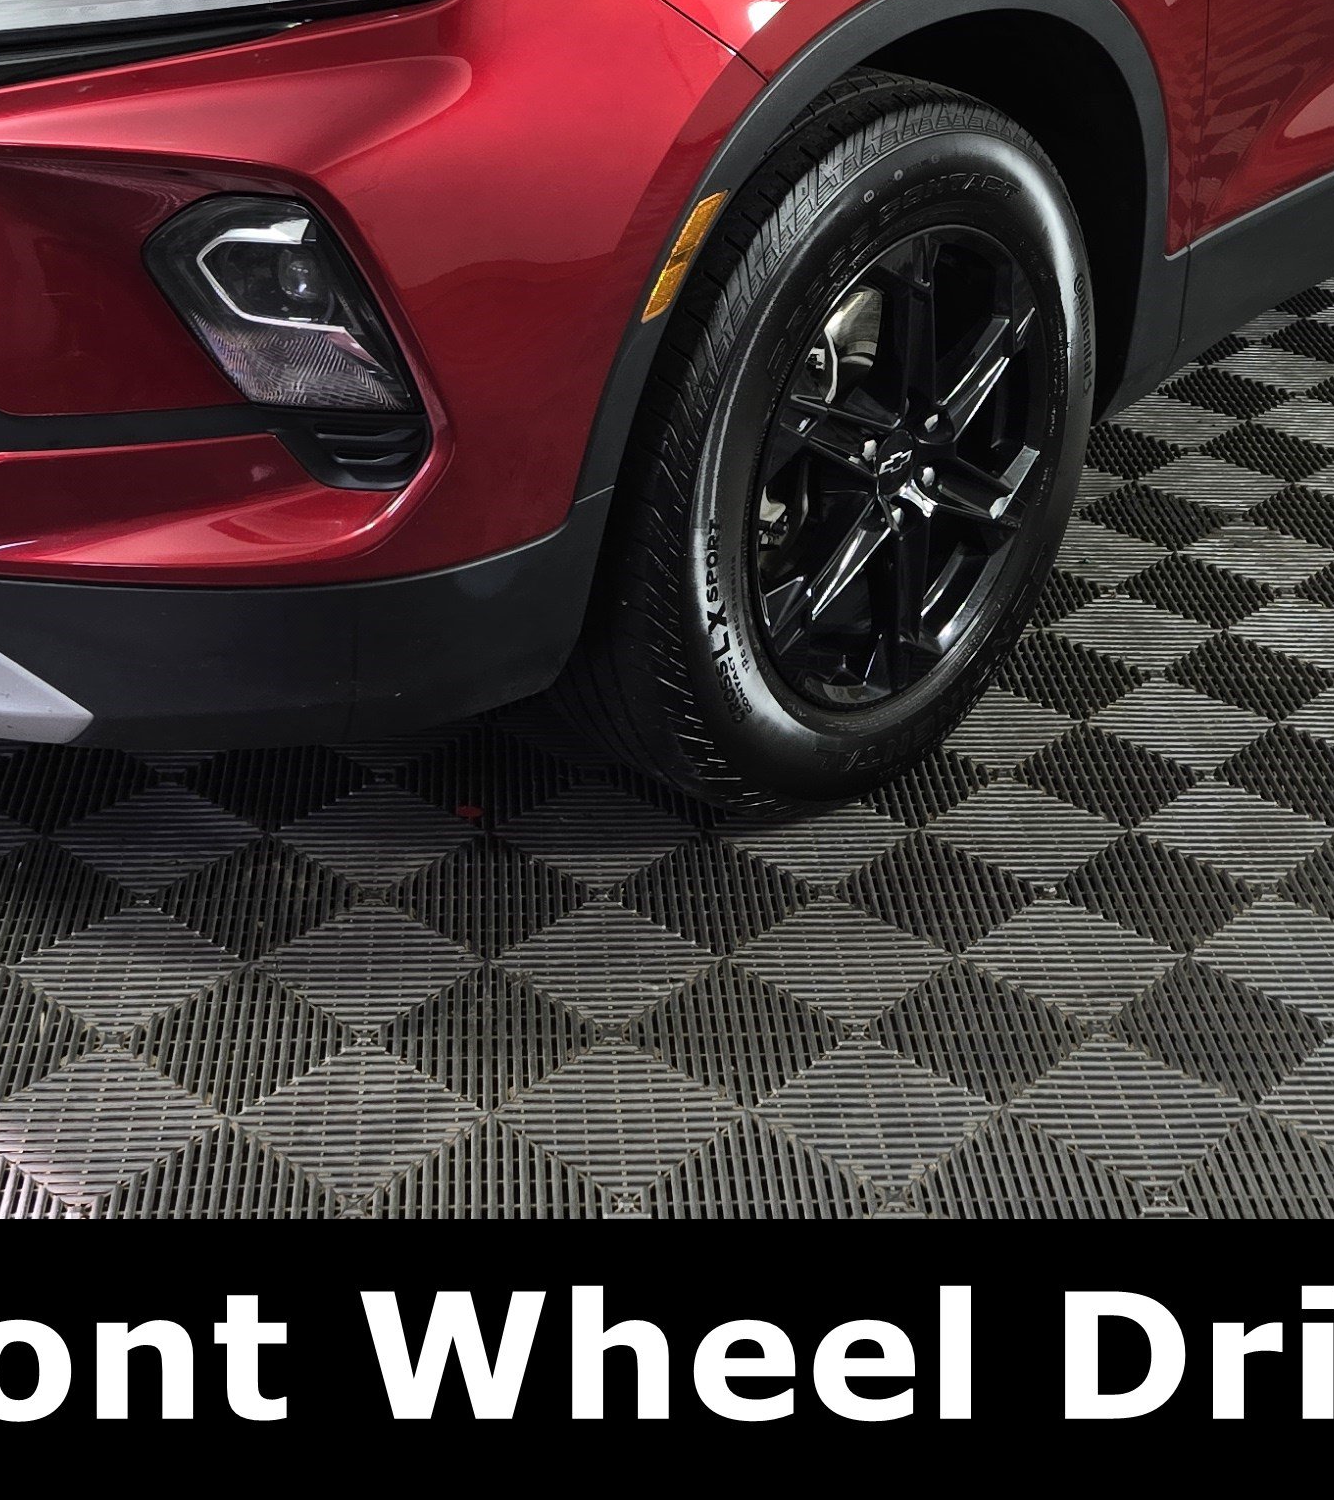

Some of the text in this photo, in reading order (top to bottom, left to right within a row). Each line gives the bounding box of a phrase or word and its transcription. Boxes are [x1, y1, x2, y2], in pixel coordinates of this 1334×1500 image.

[705, 519, 719, 603] SPORT
[716, 659, 747, 725] CROSS
[727, 656, 754, 714] CONTACT
